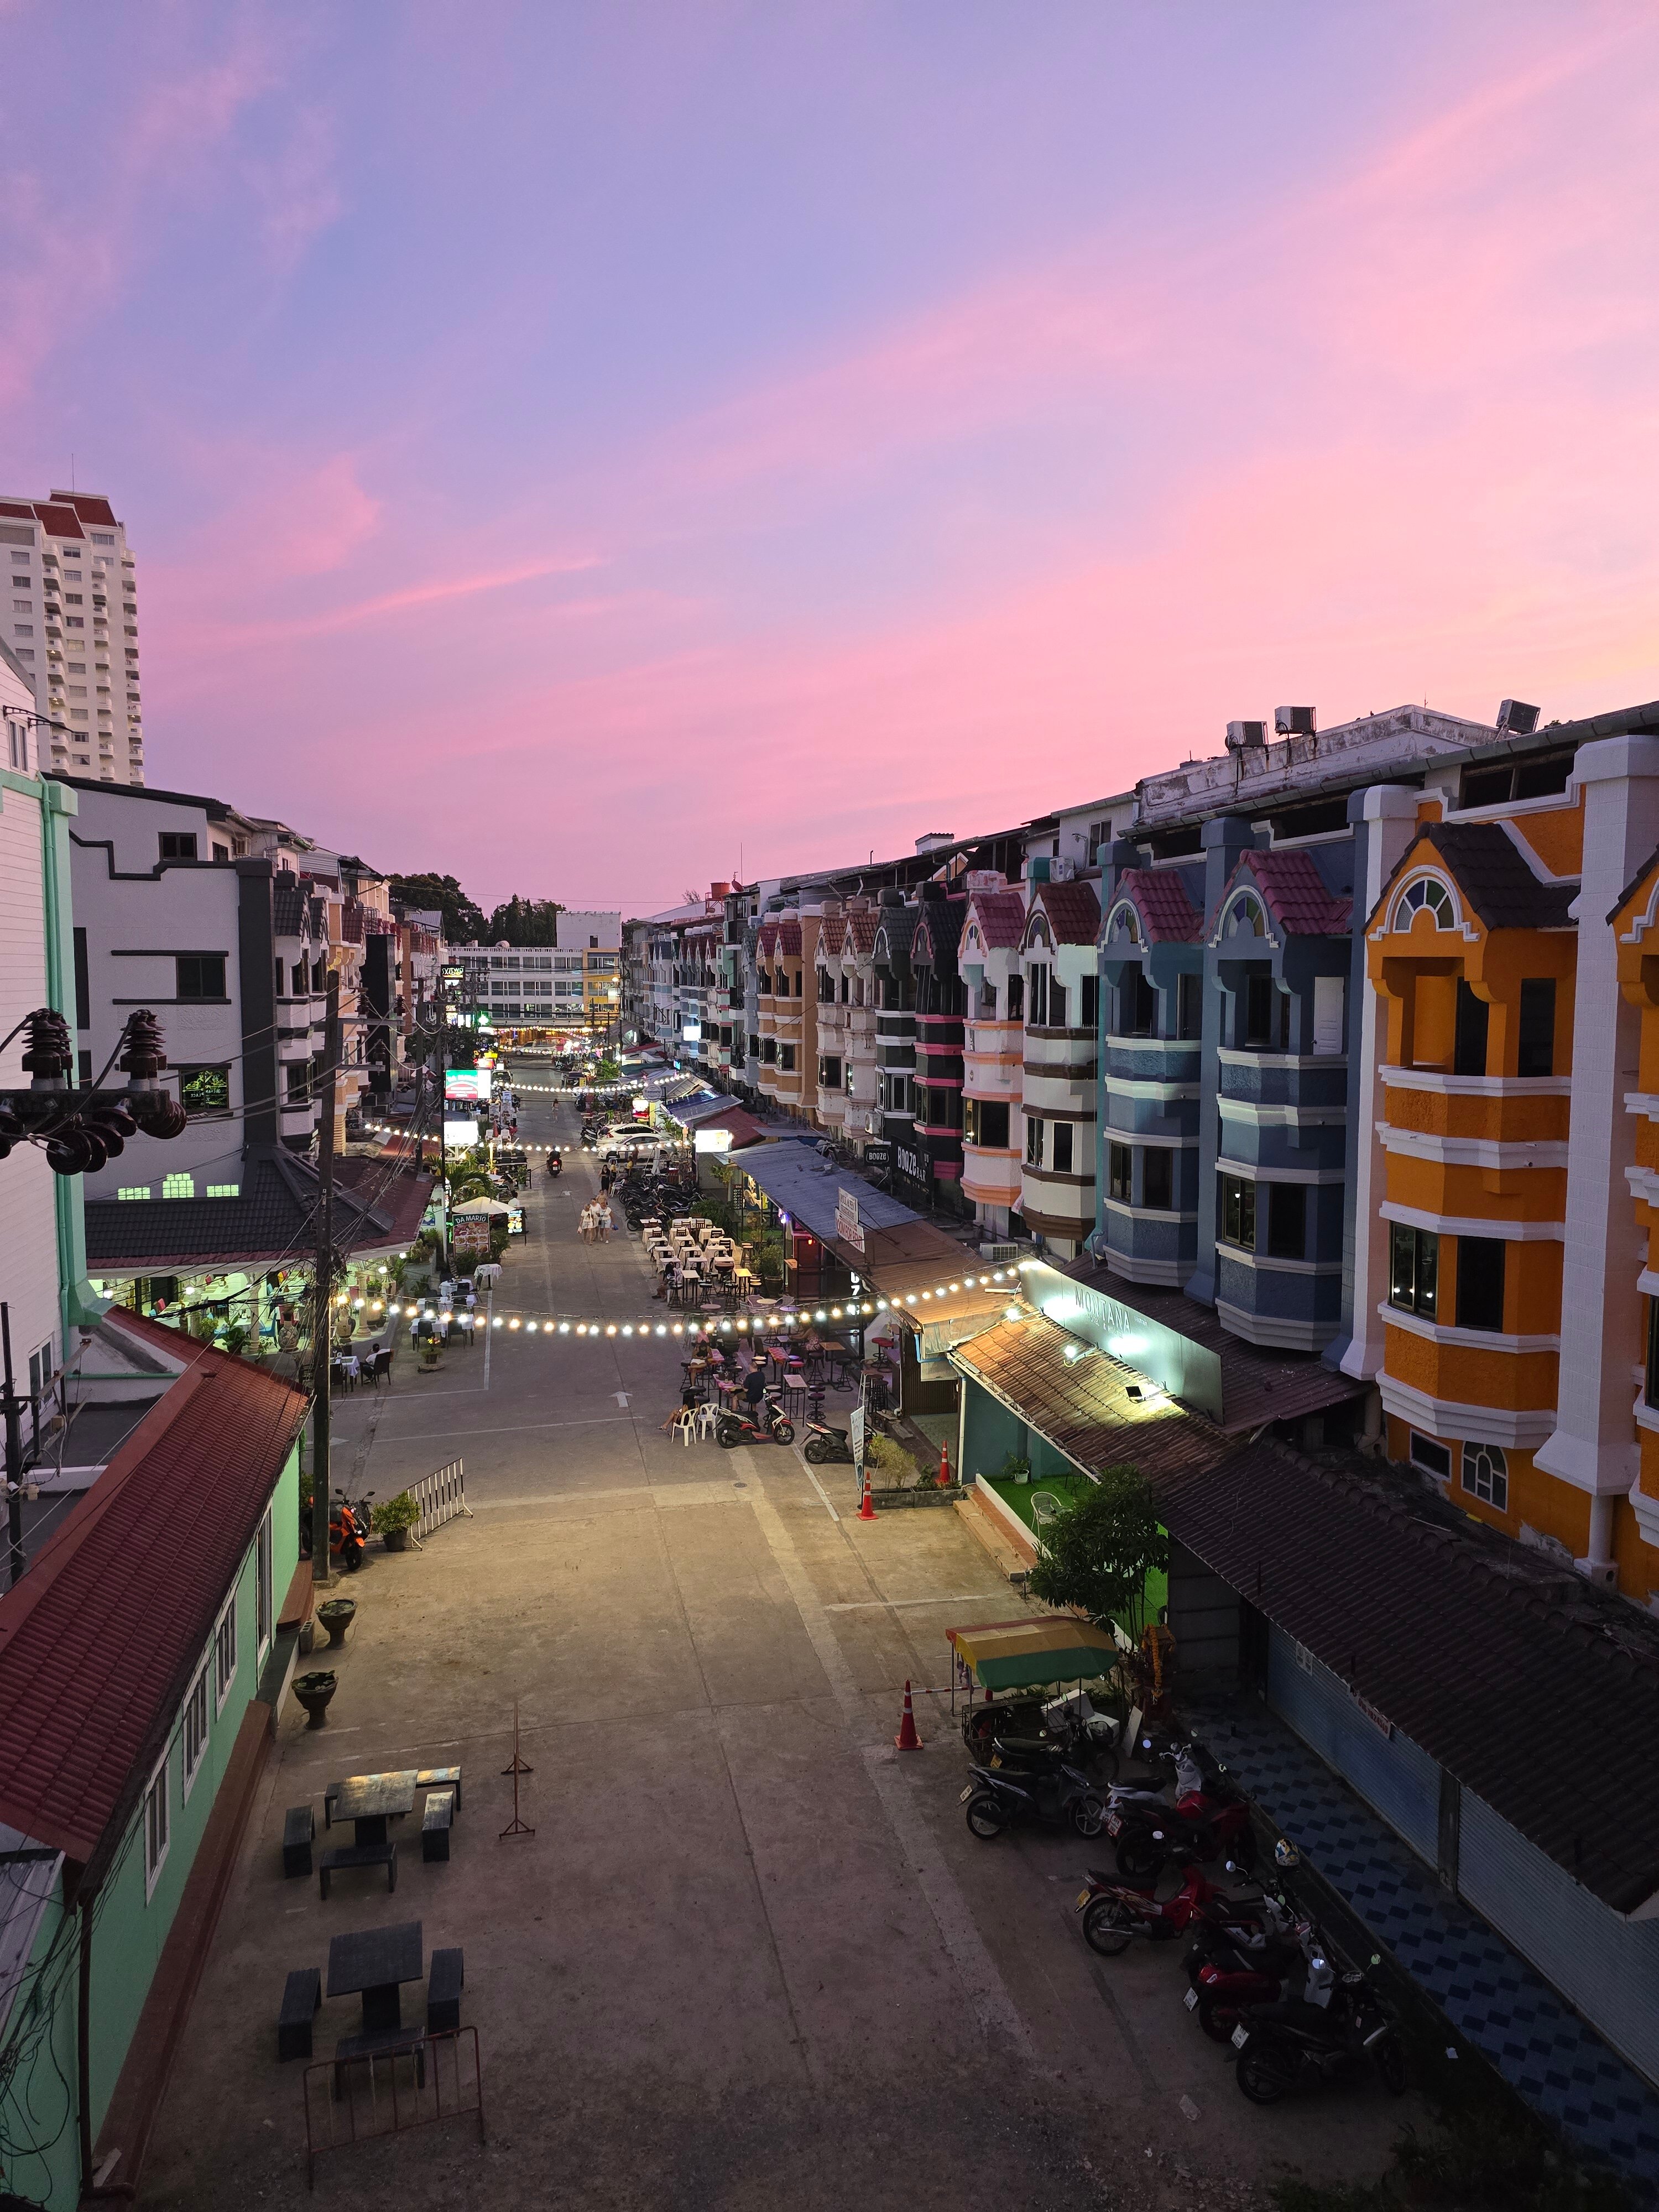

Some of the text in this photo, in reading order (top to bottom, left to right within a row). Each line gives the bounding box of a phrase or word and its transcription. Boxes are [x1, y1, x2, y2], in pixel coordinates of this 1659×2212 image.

[916, 1166, 926, 1182] BAR
[1075, 1286, 1131, 1334] MONTANA
[1087, 1314, 1099, 1327] HOTEL
